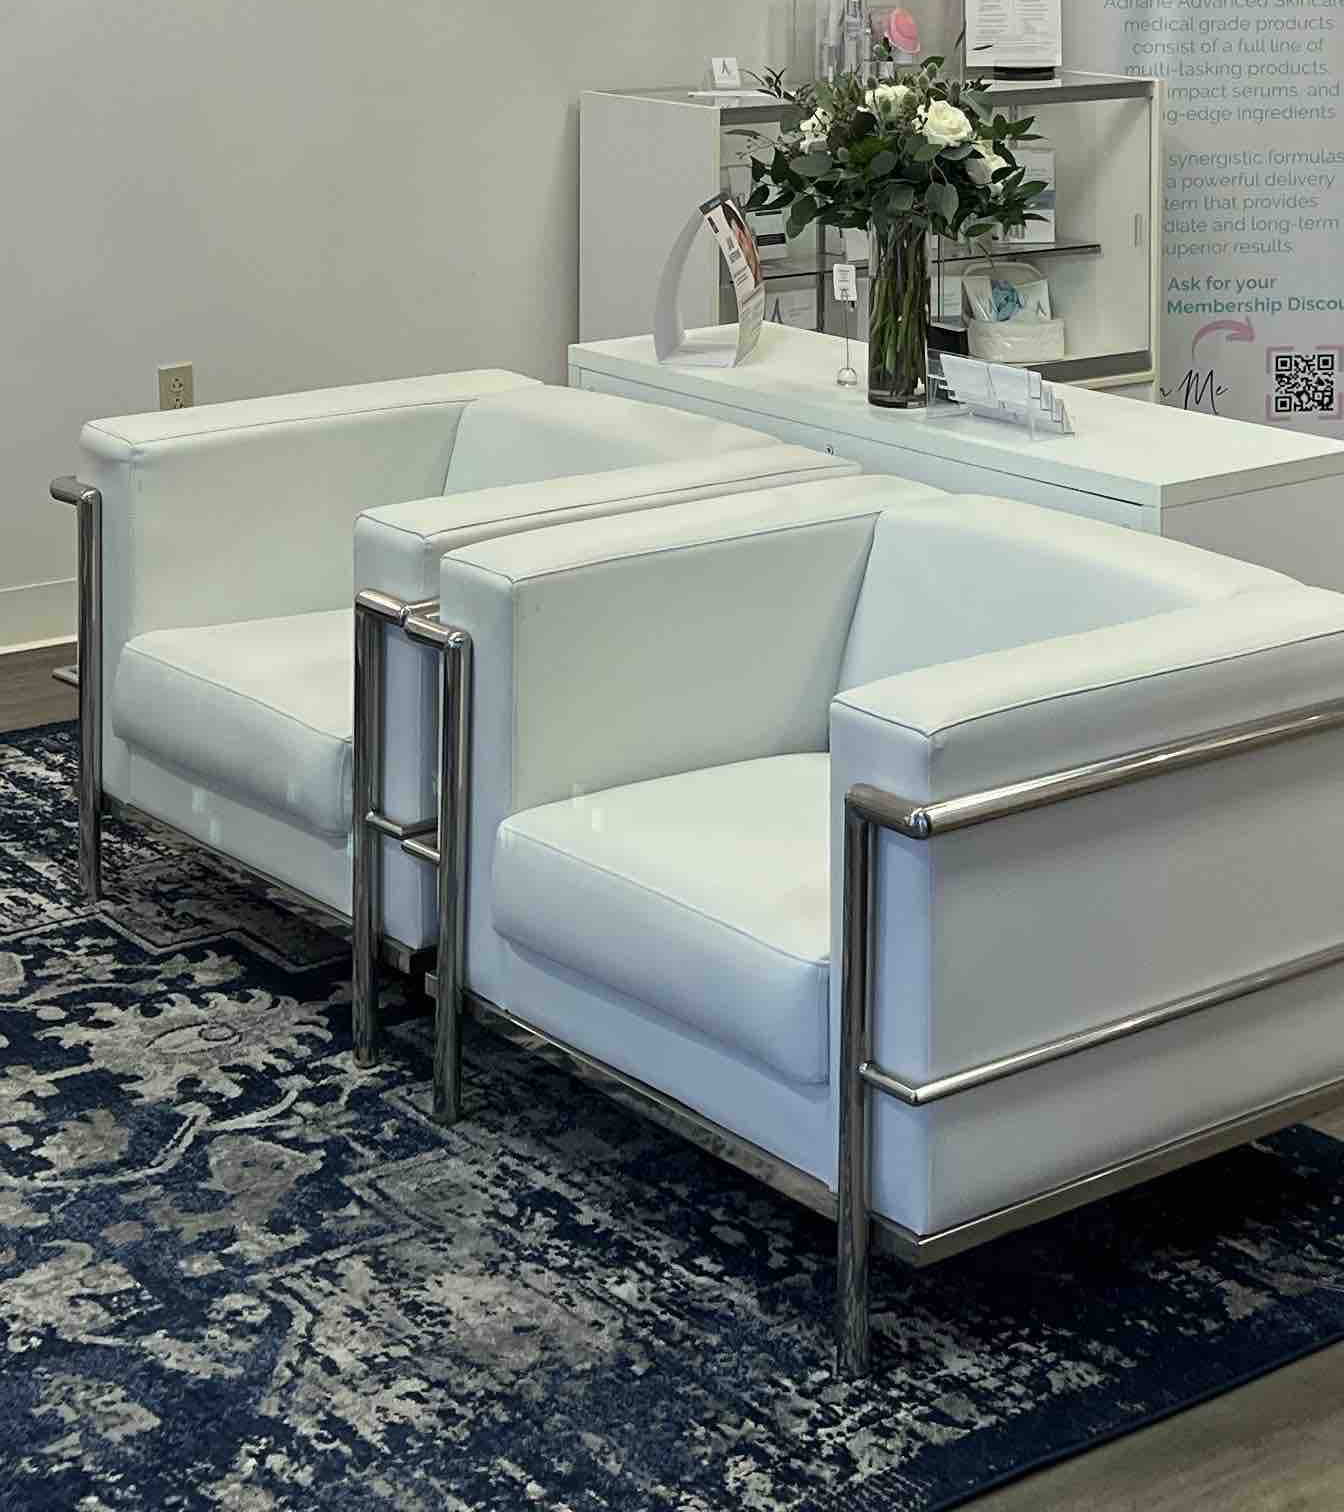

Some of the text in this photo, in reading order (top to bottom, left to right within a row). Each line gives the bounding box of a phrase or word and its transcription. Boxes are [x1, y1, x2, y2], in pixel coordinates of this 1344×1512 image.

[1124, 15, 1335, 34] medical grade products
[1131, 37, 1324, 55] consist of a full line of
[1125, 61, 1242, 79] multi-tasking
[1167, 83, 1227, 102] impact
[1306, 80, 1341, 96] and
[1168, 147, 1344, 169] synergistic formulas
[1166, 170, 1336, 192] a powerful delivery
[1164, 193, 1319, 215] tem that provides
[1163, 214, 1340, 234] diate and long-term
[1167, 275, 1277, 292] Ask for your
[1167, 296, 1283, 315] Membership
